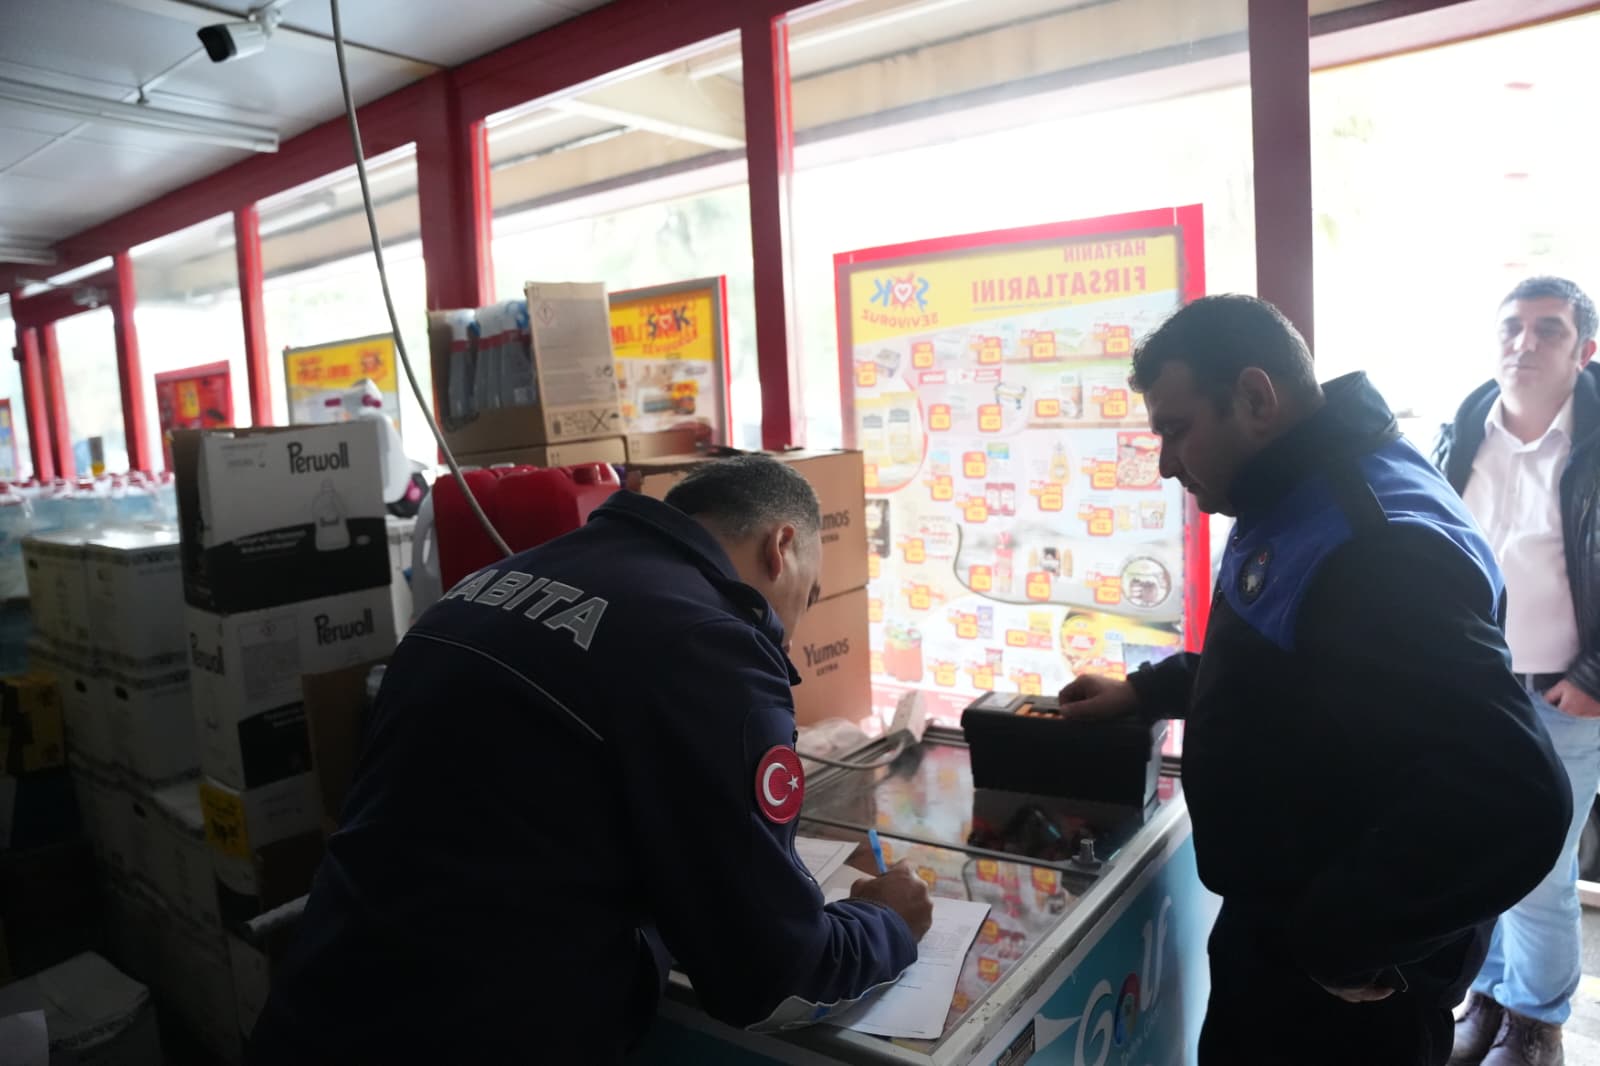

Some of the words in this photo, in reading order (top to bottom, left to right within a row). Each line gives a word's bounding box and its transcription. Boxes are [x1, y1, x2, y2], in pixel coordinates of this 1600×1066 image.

[286, 441, 350, 474] Perwoll
[314, 608, 375, 646] Perwoll
[438, 569, 608, 651] ABITA
[803, 638, 849, 667] Yumos
